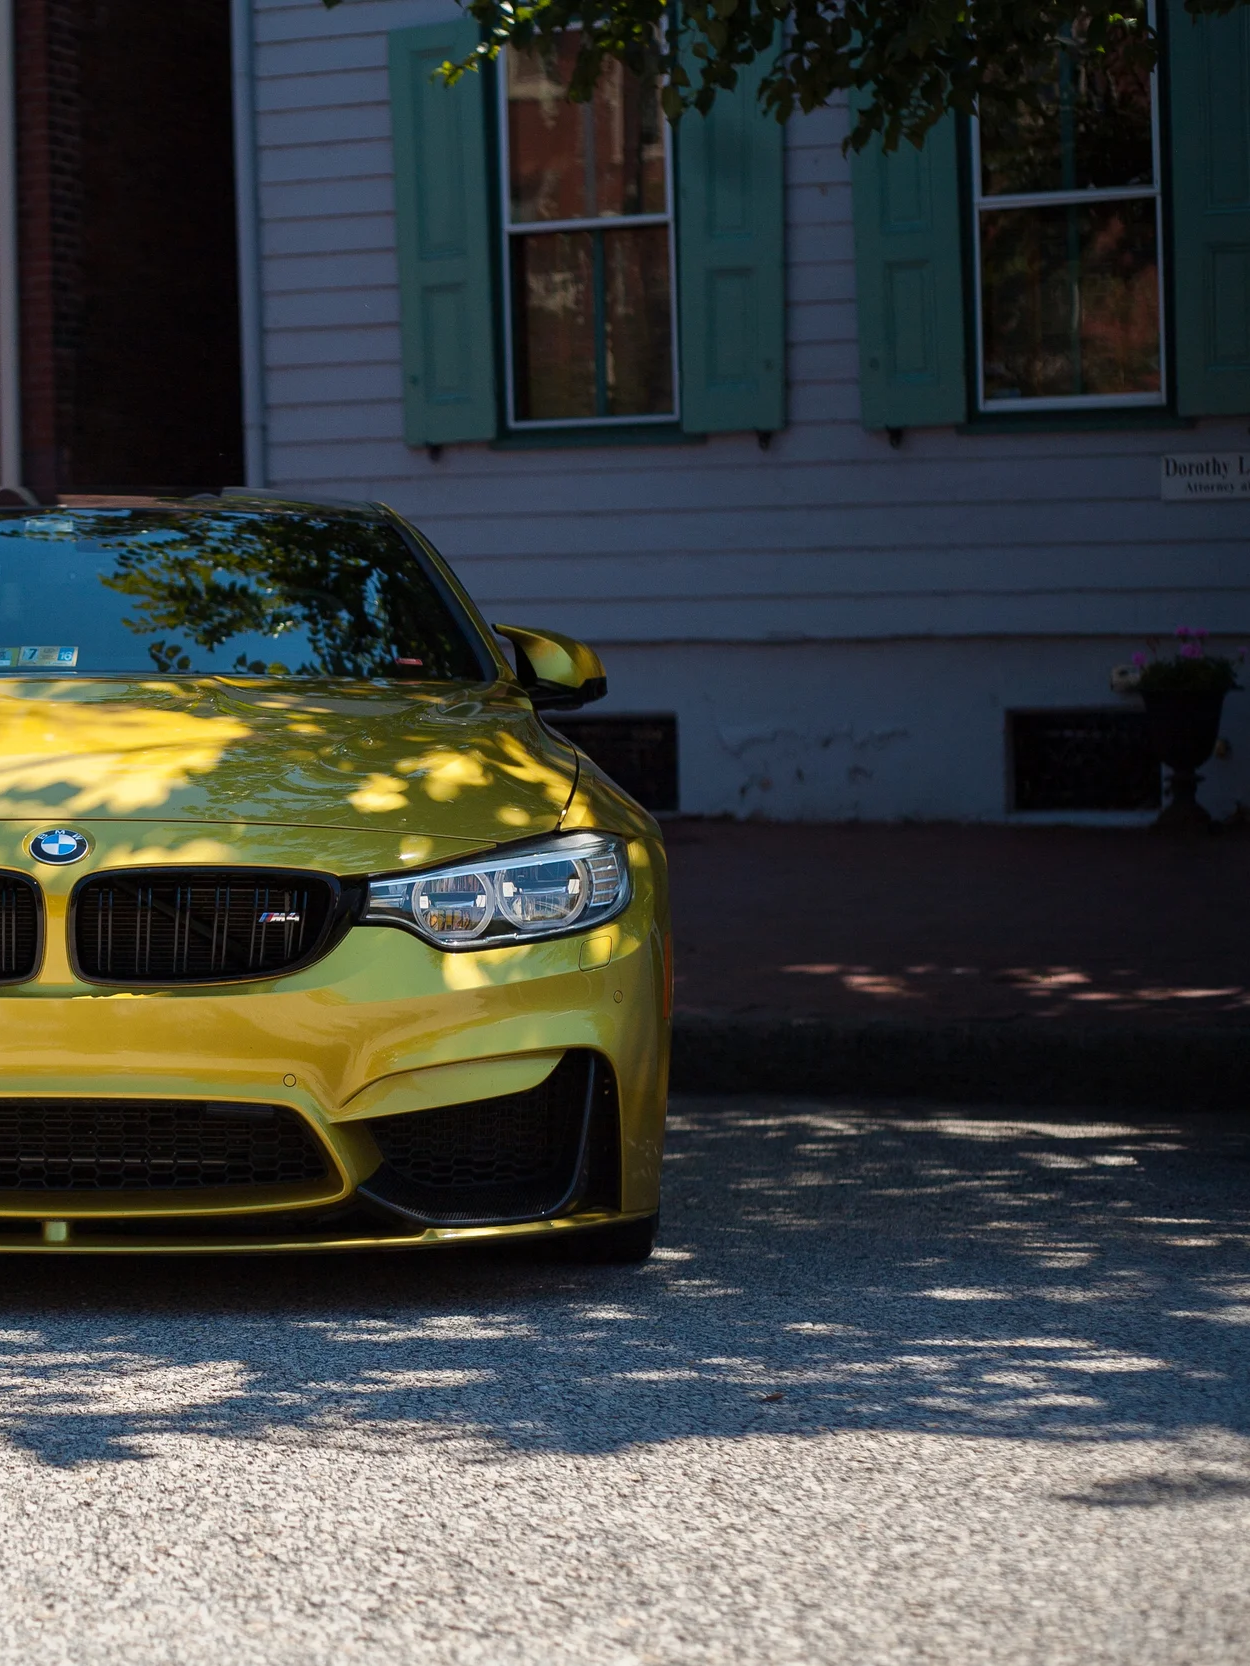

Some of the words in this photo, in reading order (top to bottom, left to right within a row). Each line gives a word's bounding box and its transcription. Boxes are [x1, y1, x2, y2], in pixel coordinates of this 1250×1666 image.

[1164, 456, 1229, 479] Dorothy
[1186, 482, 1235, 494] Attorney
[28, 648, 38, 660] 7
[59, 651, 73, 661] 16
[263, 912, 300, 923] M4
